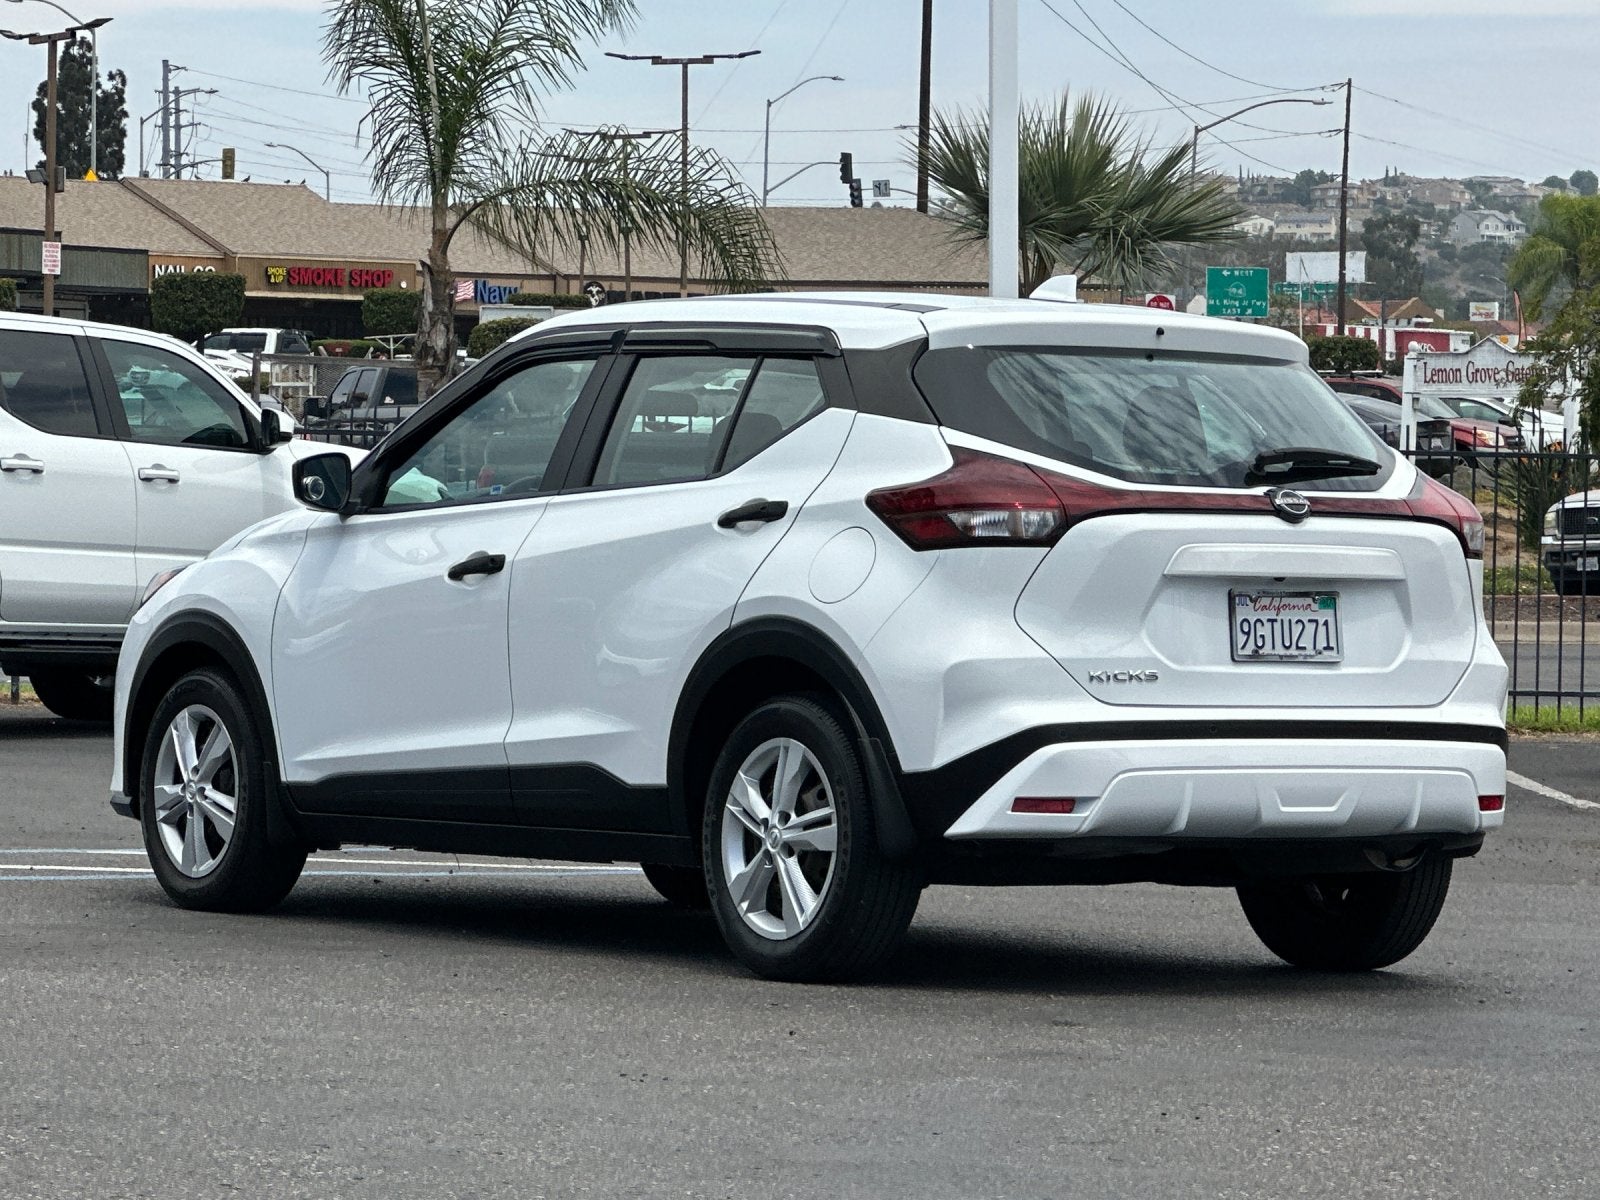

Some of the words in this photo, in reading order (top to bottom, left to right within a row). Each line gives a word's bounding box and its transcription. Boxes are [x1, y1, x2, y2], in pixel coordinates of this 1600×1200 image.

[267, 266, 287, 275] SMOKE
[275, 275, 284, 283] UP
[288, 267, 347, 286] SMOKE
[350, 269, 394, 287] SHOP
[1423, 361, 1462, 384] Lemon
[1466, 361, 1499, 384] Grove
[1253, 597, 1319, 616] California
[1240, 618, 1334, 650] 9GTU271
[1088, 669, 1159, 683] KICKS
